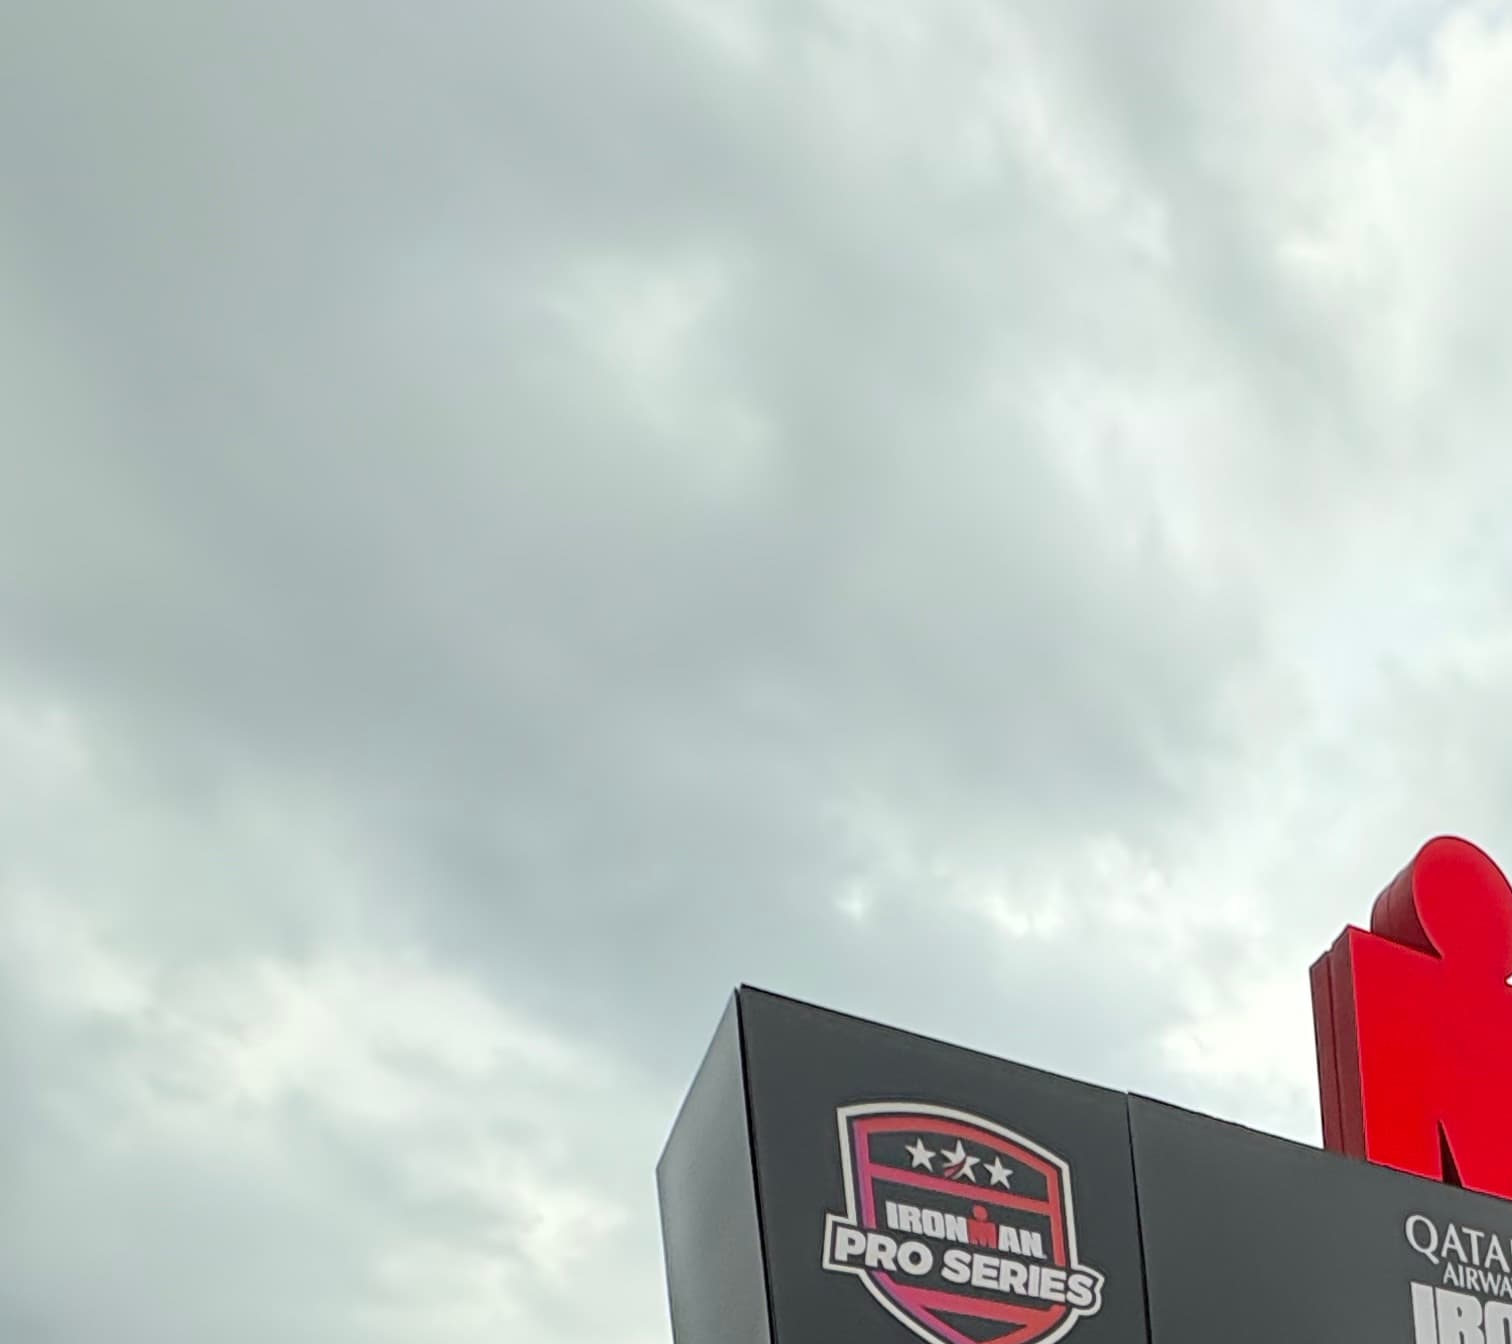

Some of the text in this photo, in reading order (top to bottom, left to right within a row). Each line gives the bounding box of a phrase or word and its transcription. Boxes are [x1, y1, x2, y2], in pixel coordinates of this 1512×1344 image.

[885, 1200, 1047, 1260] IRONMAN
[834, 1226, 1094, 1306] PRO SERIES
